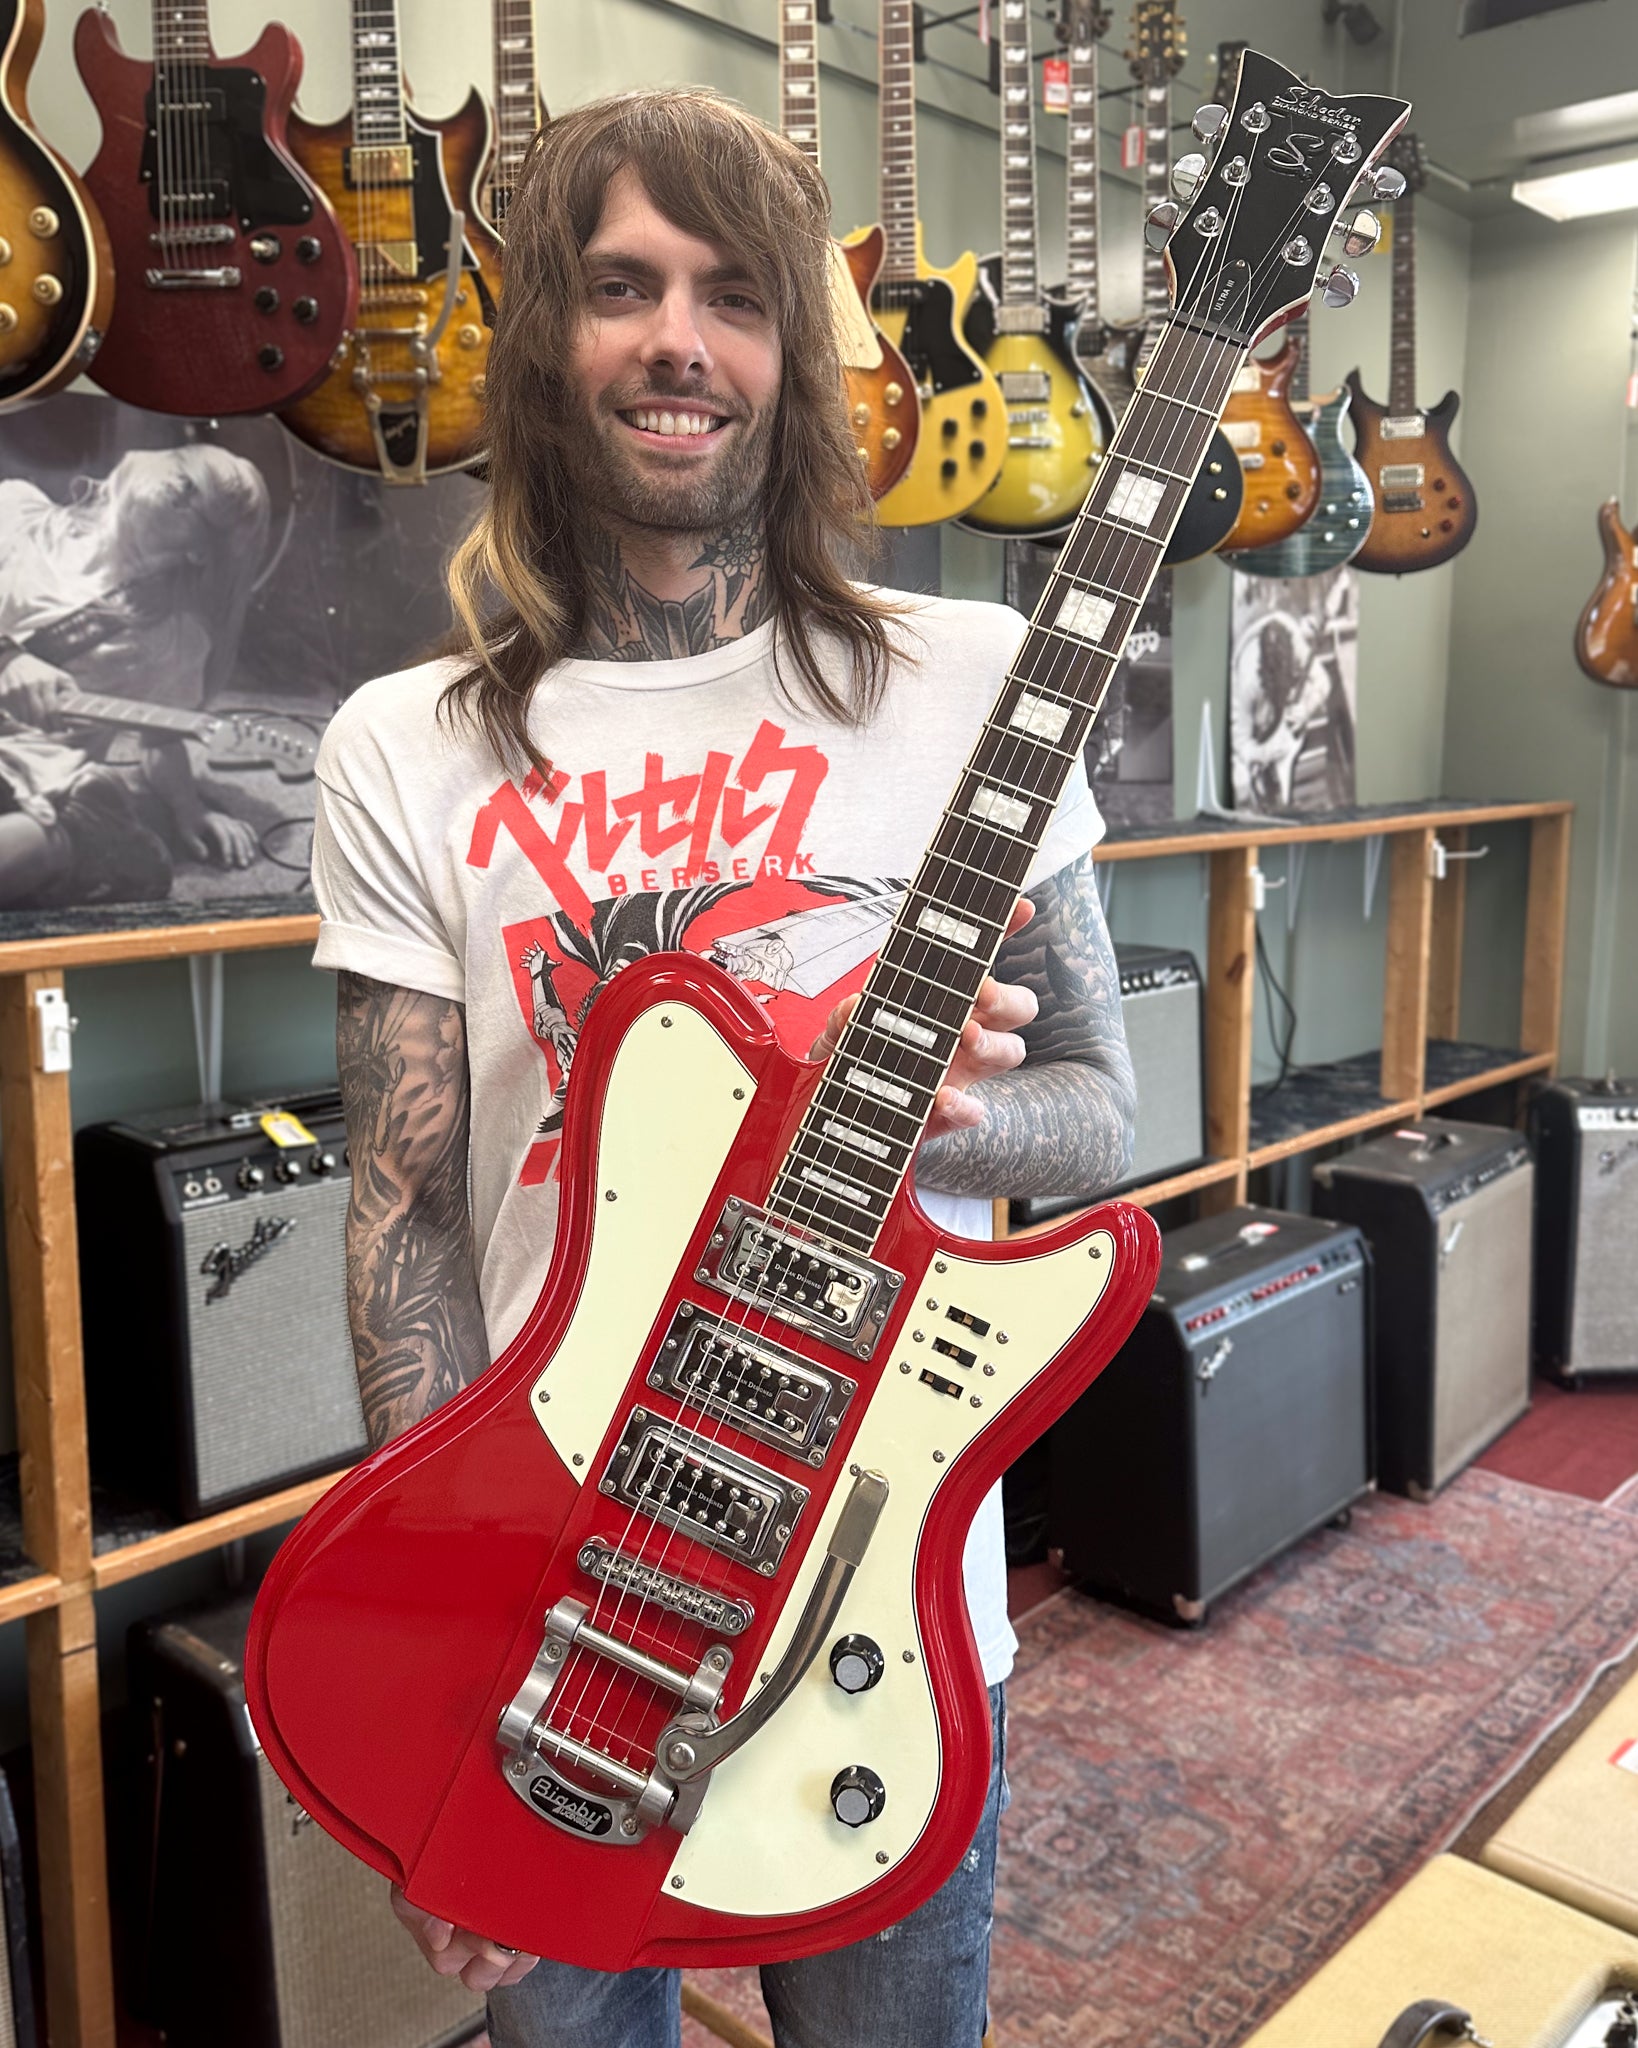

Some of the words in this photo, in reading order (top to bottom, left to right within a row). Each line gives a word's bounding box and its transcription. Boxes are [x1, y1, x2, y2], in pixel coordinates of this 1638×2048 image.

[1271, 99, 1319, 119] DIAMOND
[1319, 114, 1357, 131] SERIES
[1213, 288, 1231, 311] ULTRA
[1226, 279, 1236, 288] III
[465, 718, 830, 940] ベルセルク
[606, 852, 817, 897] BERSERK
